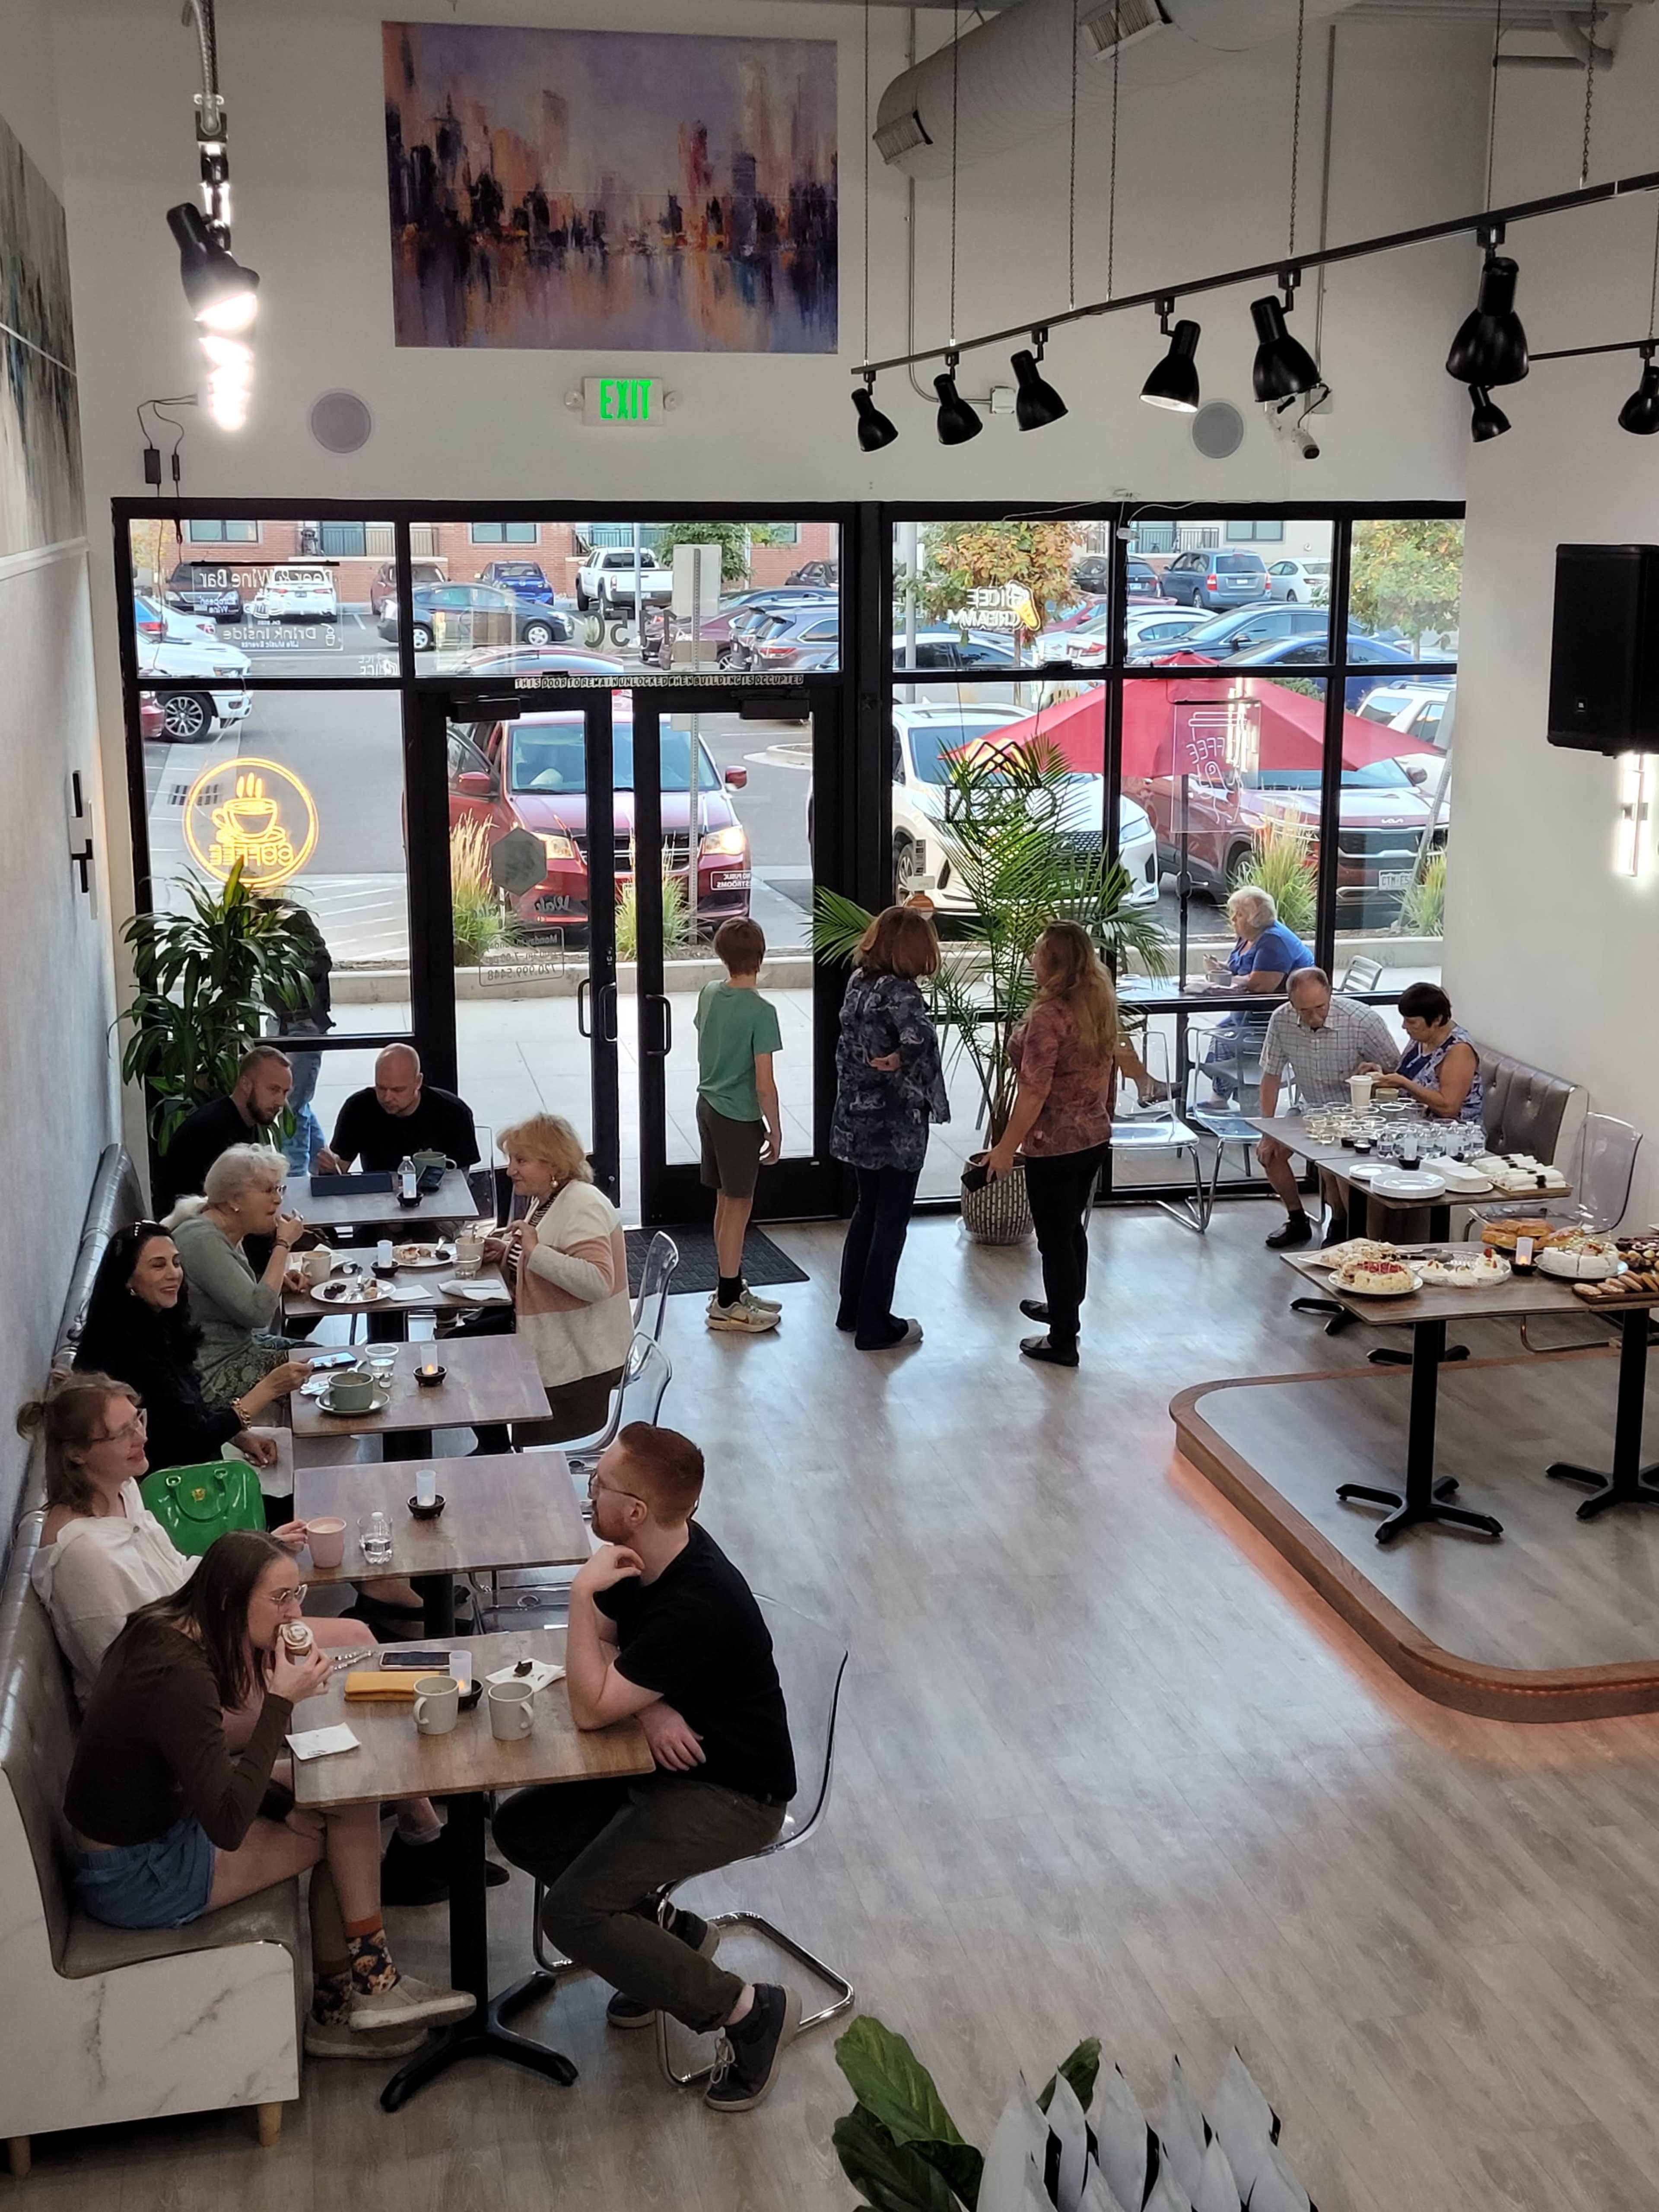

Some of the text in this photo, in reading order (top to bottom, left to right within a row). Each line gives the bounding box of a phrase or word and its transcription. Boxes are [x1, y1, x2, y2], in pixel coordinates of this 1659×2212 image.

[600, 379, 652, 420] EXIT
[516, 679, 540, 688] THIS
[542, 678, 566, 687] DOOR
[568, 678, 580, 686] TO
[582, 677, 618, 686] REMAIN
[620, 677, 667, 686] UNLOCKED
[694, 676, 741, 685] BUILDING
[743, 675, 753, 684] IS
[755, 675, 804, 684] OCCUPIED
